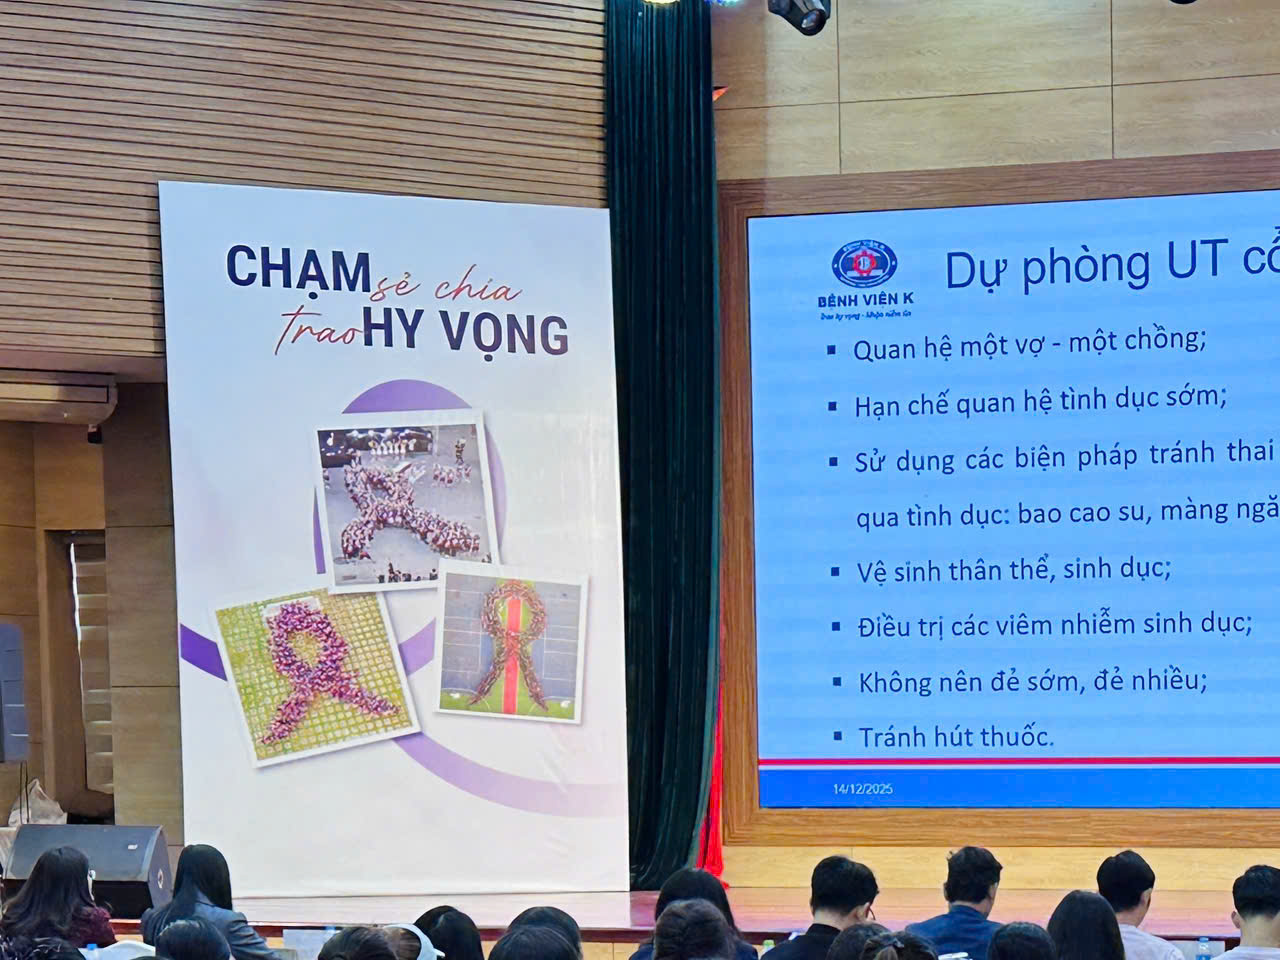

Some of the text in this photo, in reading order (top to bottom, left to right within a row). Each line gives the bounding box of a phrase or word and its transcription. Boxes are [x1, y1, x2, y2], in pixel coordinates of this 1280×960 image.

[226, 244, 371, 300] CHẠM
[434, 264, 522, 301] chia
[946, 251, 1008, 294] Dự
[1023, 244, 1150, 296] phòng
[1168, 238, 1229, 279] UT
[903, 292, 914, 304] K
[363, 306, 424, 349] HY
[439, 310, 568, 362] VỌNG
[853, 339, 916, 363] Quan
[924, 334, 953, 362] hệ
[960, 331, 1009, 361] một
[1015, 335, 1046, 358] vợ
[1069, 327, 1118, 356] một
[1124, 322, 1206, 353] chồng;
[855, 382, 1227, 421] Hạn chế quan hệ tình dục sớm;
[855, 447, 887, 473] Sử
[896, 448, 955, 476] dụng
[965, 445, 1004, 470] các
[1015, 443, 1066, 472] biện
[1078, 441, 1138, 472] pháp
[1149, 439, 1215, 465] tránh
[1226, 438, 1274, 462] thai
[856, 511, 899, 534] qua
[906, 503, 952, 527] tình
[960, 503, 1010, 530] dục:
[1018, 501, 1062, 524] bao
[1069, 506, 1111, 523] cao
[1118, 504, 1152, 525] su,
[1161, 496, 1229, 525] màng
[856, 552, 1171, 587] Vệ sinh thân thể, sinh dục;
[857, 606, 1252, 641] Điều trị các viêm nhiễm sinh dục;
[859, 664, 1207, 698] Không nên đẻ sớm, đẻ nhiều;
[858, 721, 1054, 748] Tránh hút thuốc.
[833, 783, 894, 795] 14/12/2025
